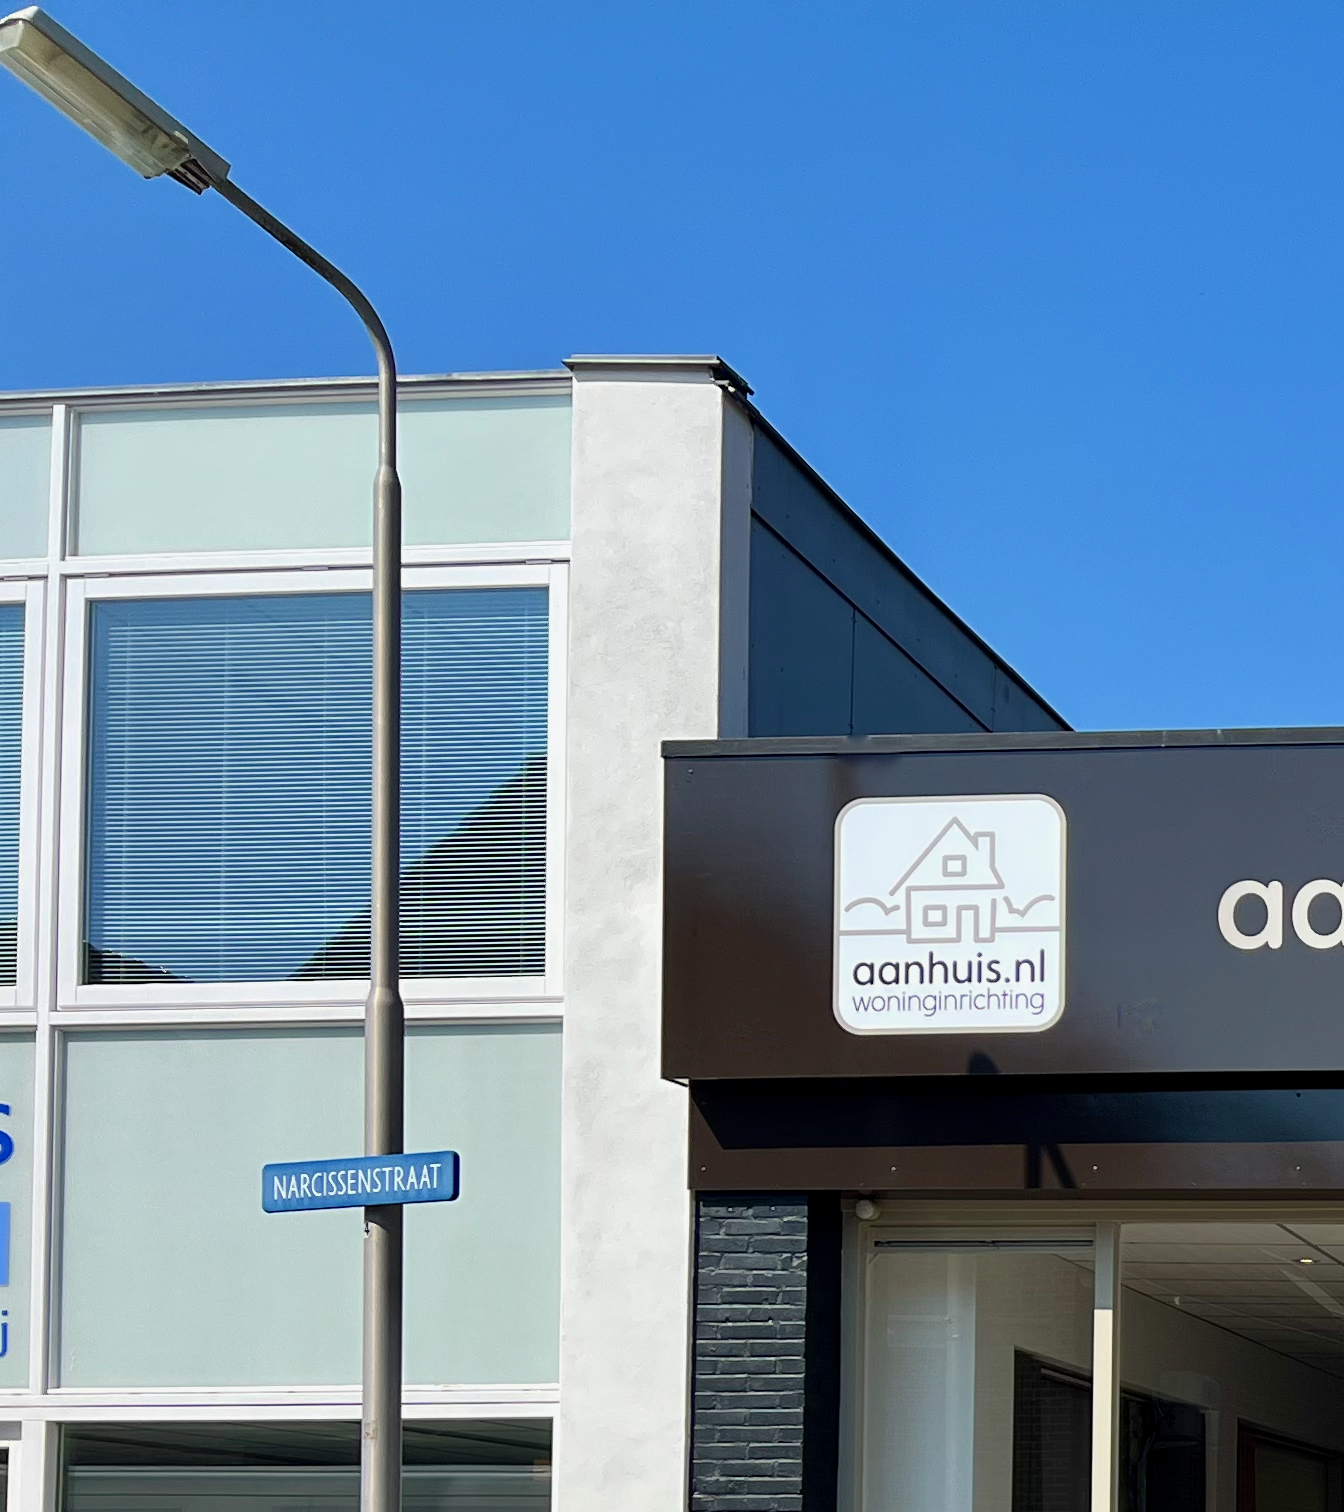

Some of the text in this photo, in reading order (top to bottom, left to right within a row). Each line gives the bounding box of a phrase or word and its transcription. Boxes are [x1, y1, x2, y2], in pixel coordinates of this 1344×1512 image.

[853, 948, 1045, 986] aanhuis.nl
[852, 988, 1045, 1017] woninginrichting
[273, 1163, 441, 1201] NARCISSENSTRAAT
